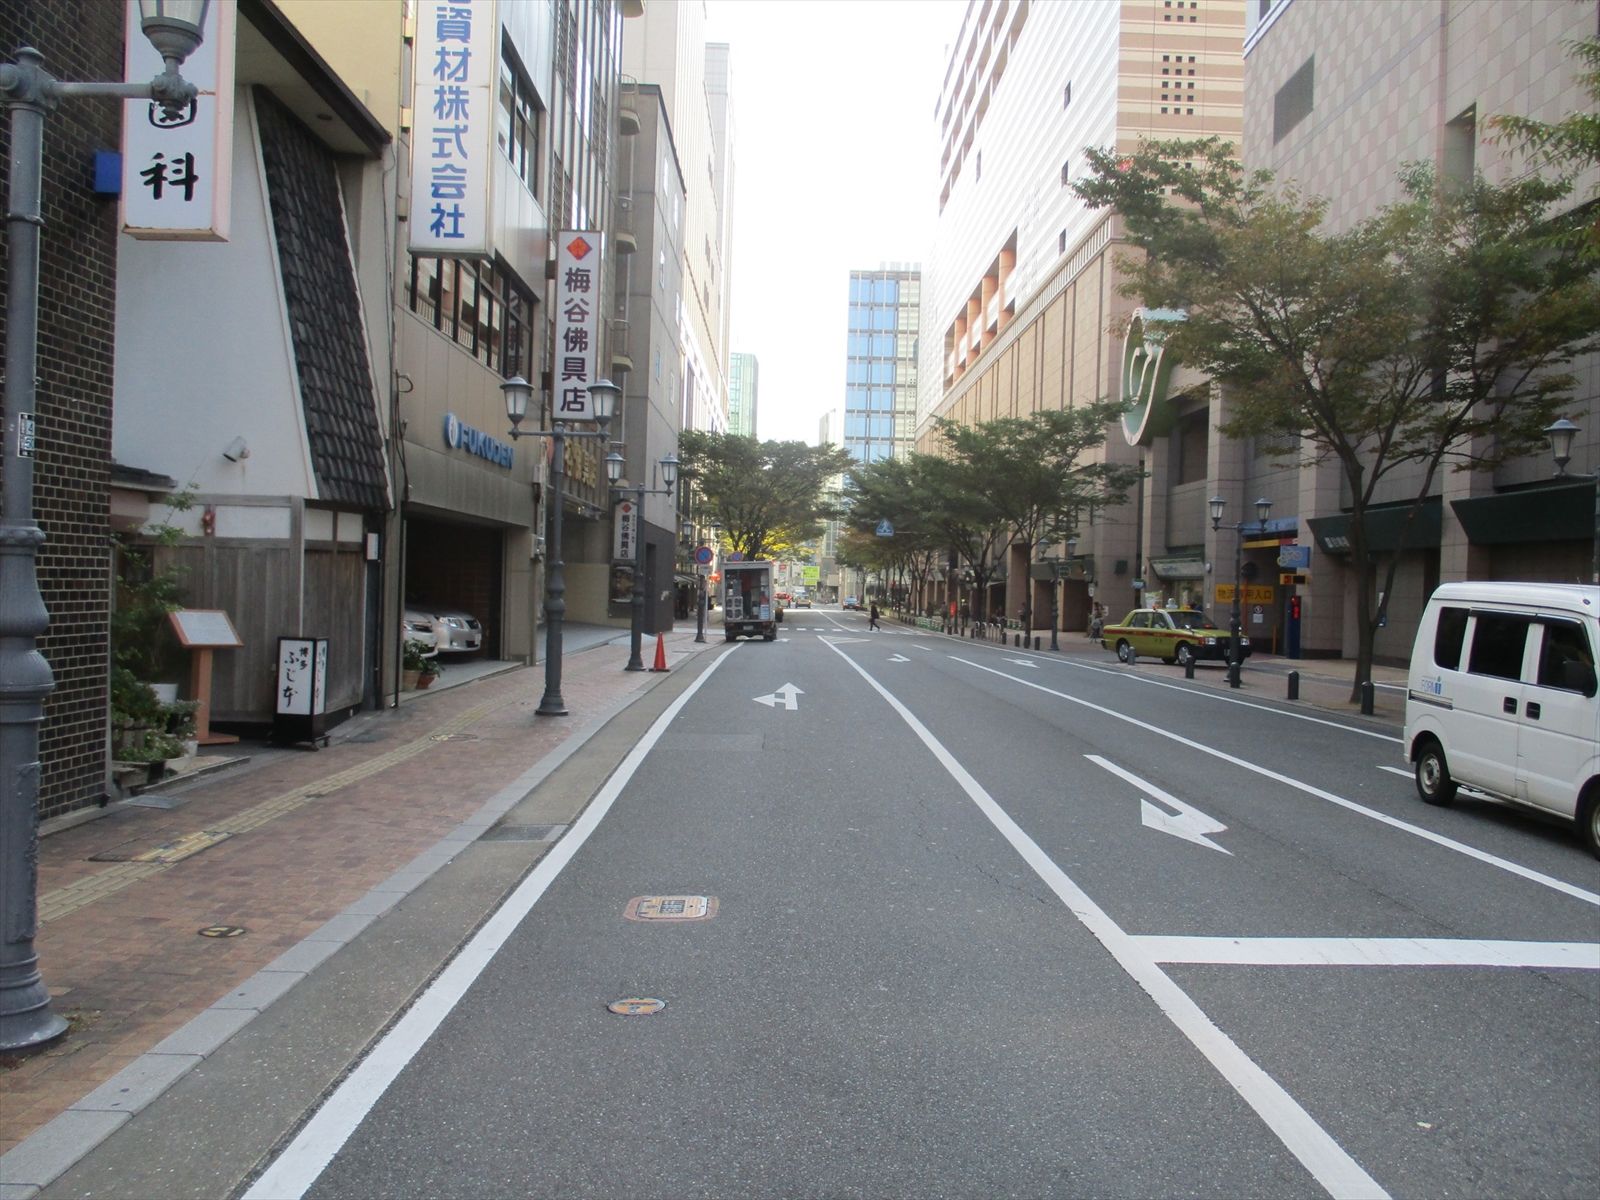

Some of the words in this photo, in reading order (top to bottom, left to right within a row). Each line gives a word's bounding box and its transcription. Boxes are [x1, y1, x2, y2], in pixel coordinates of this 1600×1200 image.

[430, 0, 472, 239] 資材株式会社
[559, 266, 591, 412] 梅谷佛具店
[458, 421, 514, 469] FUKUDEN
